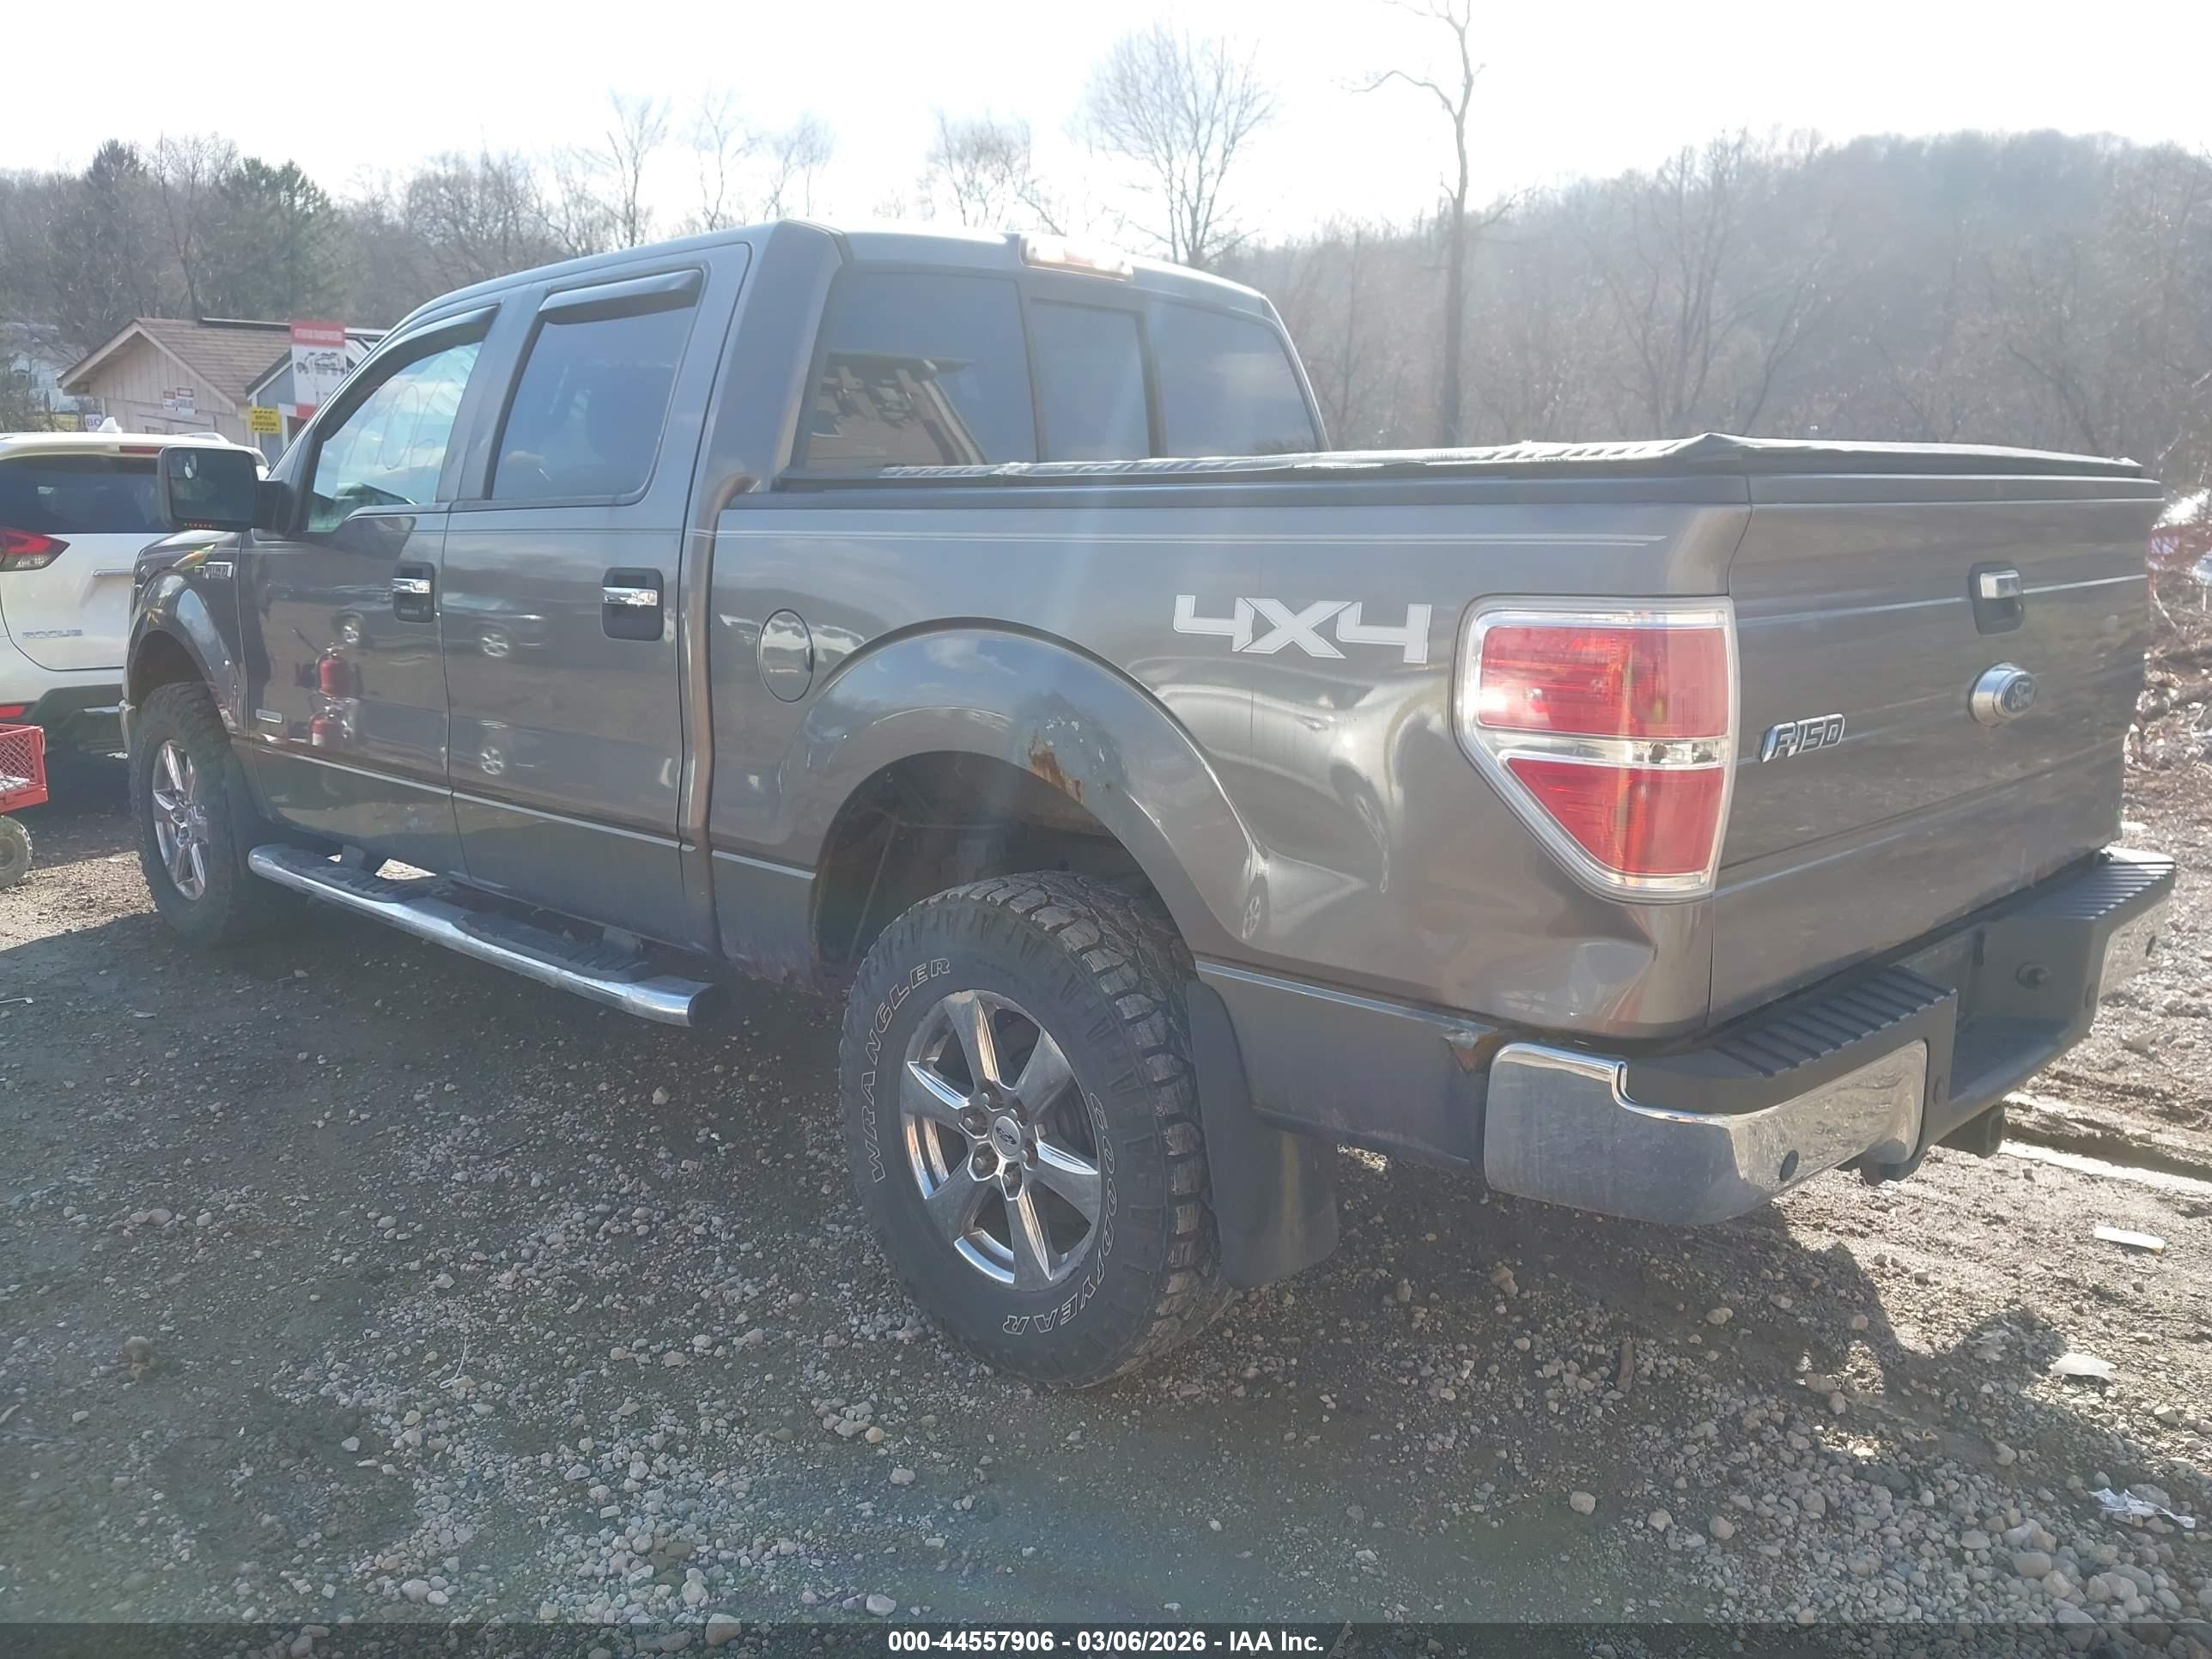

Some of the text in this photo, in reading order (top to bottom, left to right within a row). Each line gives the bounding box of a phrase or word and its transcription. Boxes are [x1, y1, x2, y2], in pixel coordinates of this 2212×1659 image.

[21, 629, 83, 639] ROGUE
[861, 957, 951, 1183] WRANGLER
[1002, 1091, 1119, 1335] GOODYEAR
